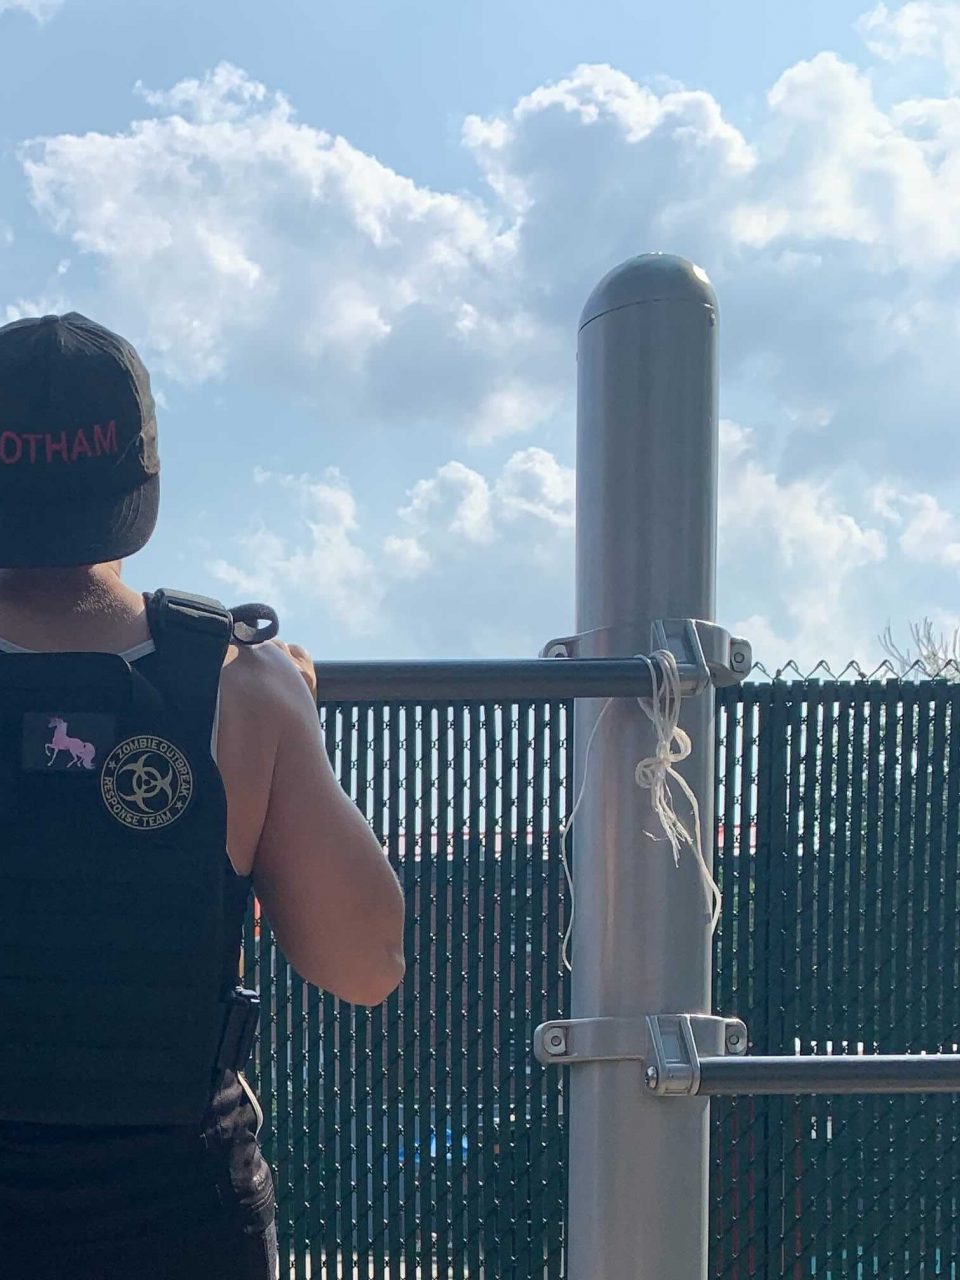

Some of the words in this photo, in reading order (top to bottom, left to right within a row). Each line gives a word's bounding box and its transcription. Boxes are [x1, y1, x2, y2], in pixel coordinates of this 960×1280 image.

[116, 738, 160, 759] ZOMBIE
[159, 743, 190, 797] OUTBREAK
[103, 776, 139, 826] RESPONSE
[142, 811, 173, 827] TEAM
